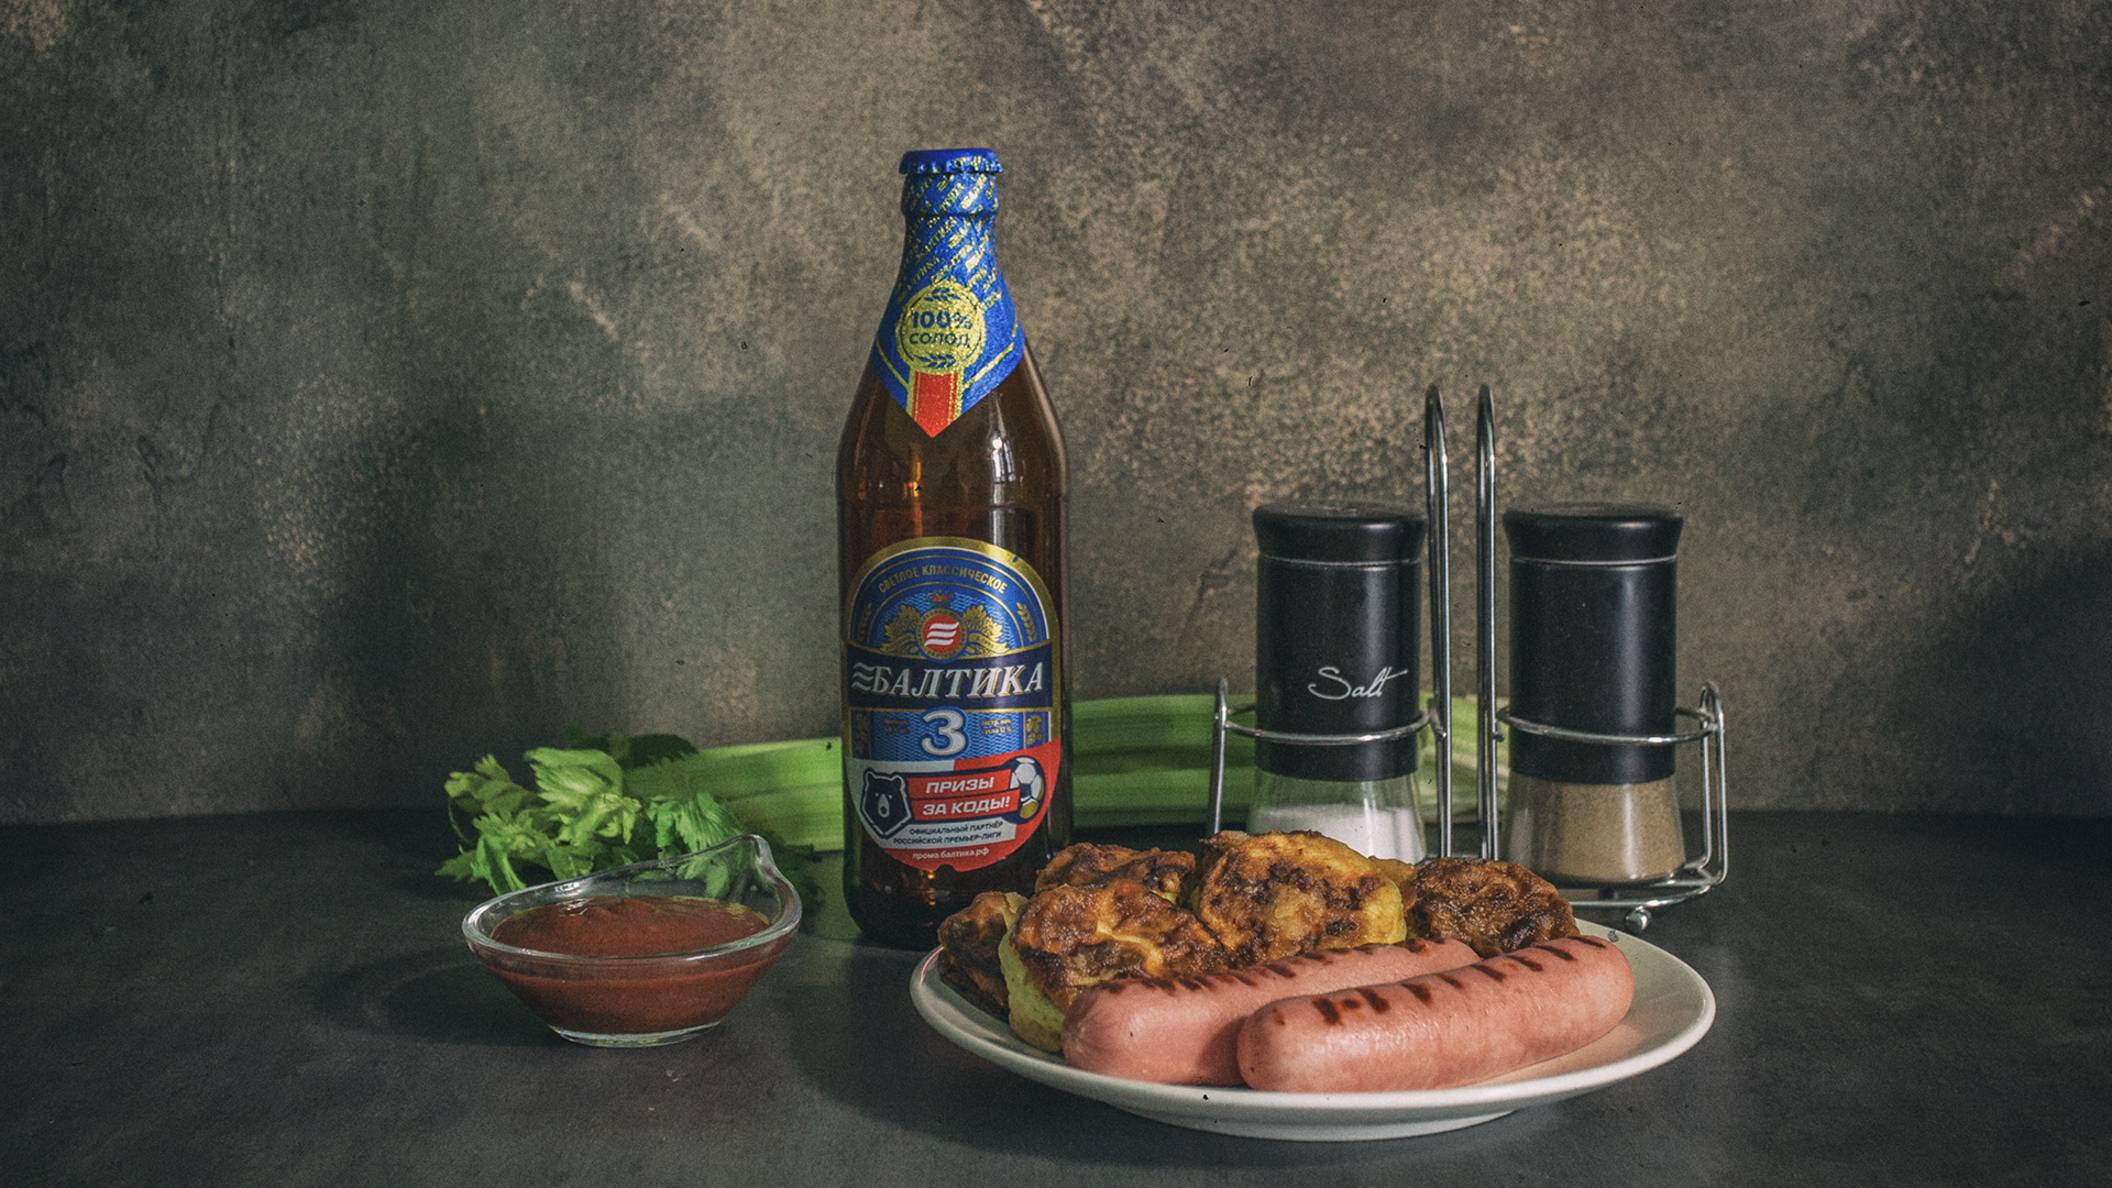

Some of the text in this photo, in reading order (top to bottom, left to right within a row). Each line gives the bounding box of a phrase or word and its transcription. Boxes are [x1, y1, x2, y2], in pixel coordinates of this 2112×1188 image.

[912, 311, 973, 330] 100%
[878, 564, 1008, 594] СВЕТЛОЕ КЛАССИЧЕСКОЕ
[872, 661, 1044, 699] БАЛТИКА
[1307, 666, 1408, 700] Salt
[921, 709, 966, 755] 3
[925, 777, 995, 794] ПРИЗЫ
[922, 796, 1011, 816] ЗА КОДЫ!
[894, 831, 1002, 845] РОССИЙСКОЙ ПРЕМЬЕР-ЛИГИ
[909, 824, 968, 835] ОФИЦИАЛЬНЫЙ
[912, 847, 990, 860] промо.балтика.рф
